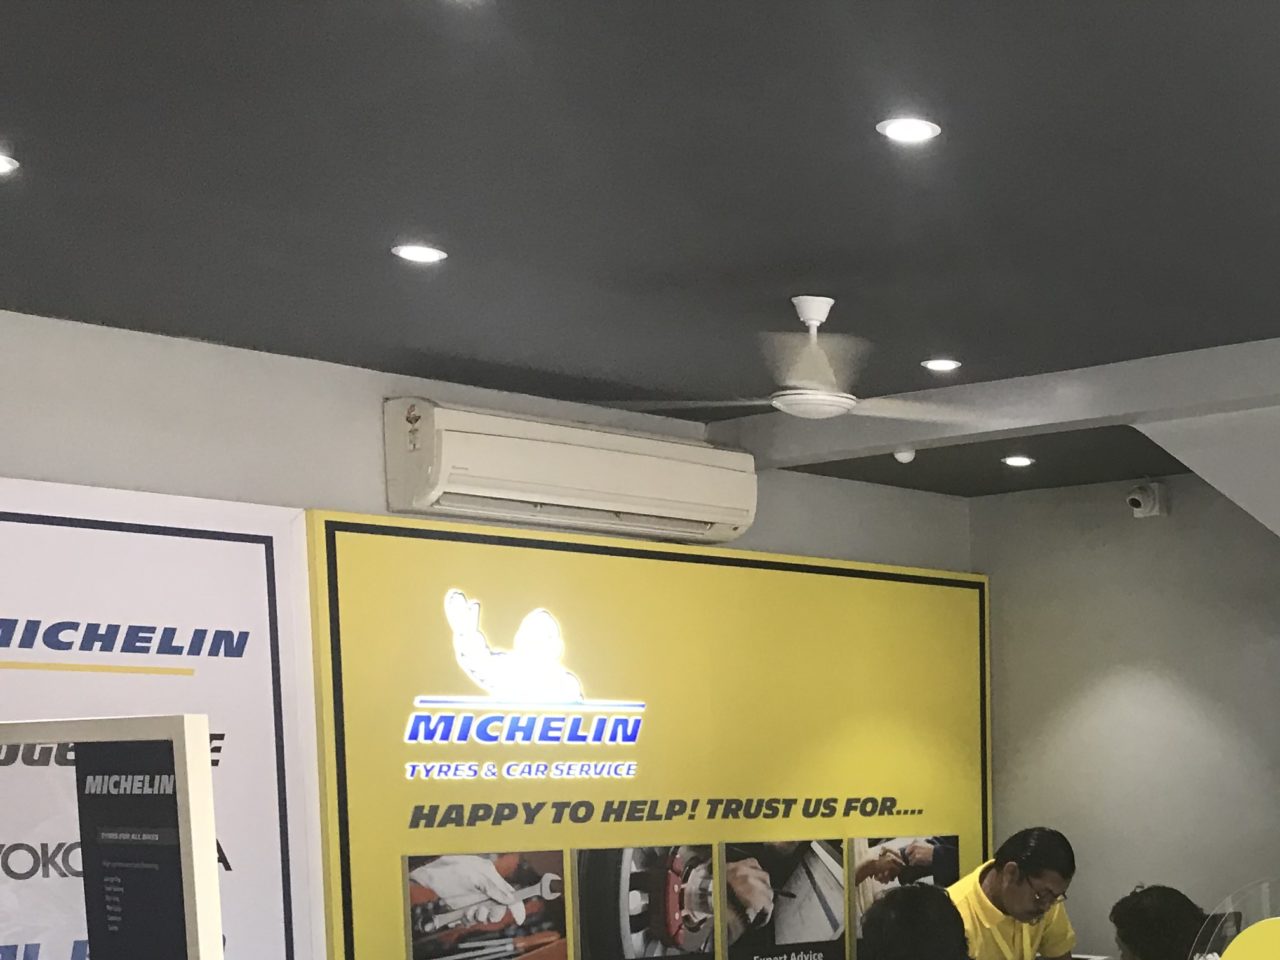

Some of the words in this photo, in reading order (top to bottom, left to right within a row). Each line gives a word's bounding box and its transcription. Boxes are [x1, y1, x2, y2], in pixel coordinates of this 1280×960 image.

[406, 714, 642, 743] MICHELIN
[407, 763, 478, 778] TYRES
[484, 763, 496, 778] &
[503, 763, 546, 777] CAR
[553, 762, 636, 777] SERVICE
[85, 774, 175, 794] MICHELIN
[409, 803, 548, 829] HAPPY
[552, 800, 595, 823] TO
[600, 799, 699, 823] HELP!
[706, 798, 797, 820] TRUST
[802, 798, 837, 818] US
